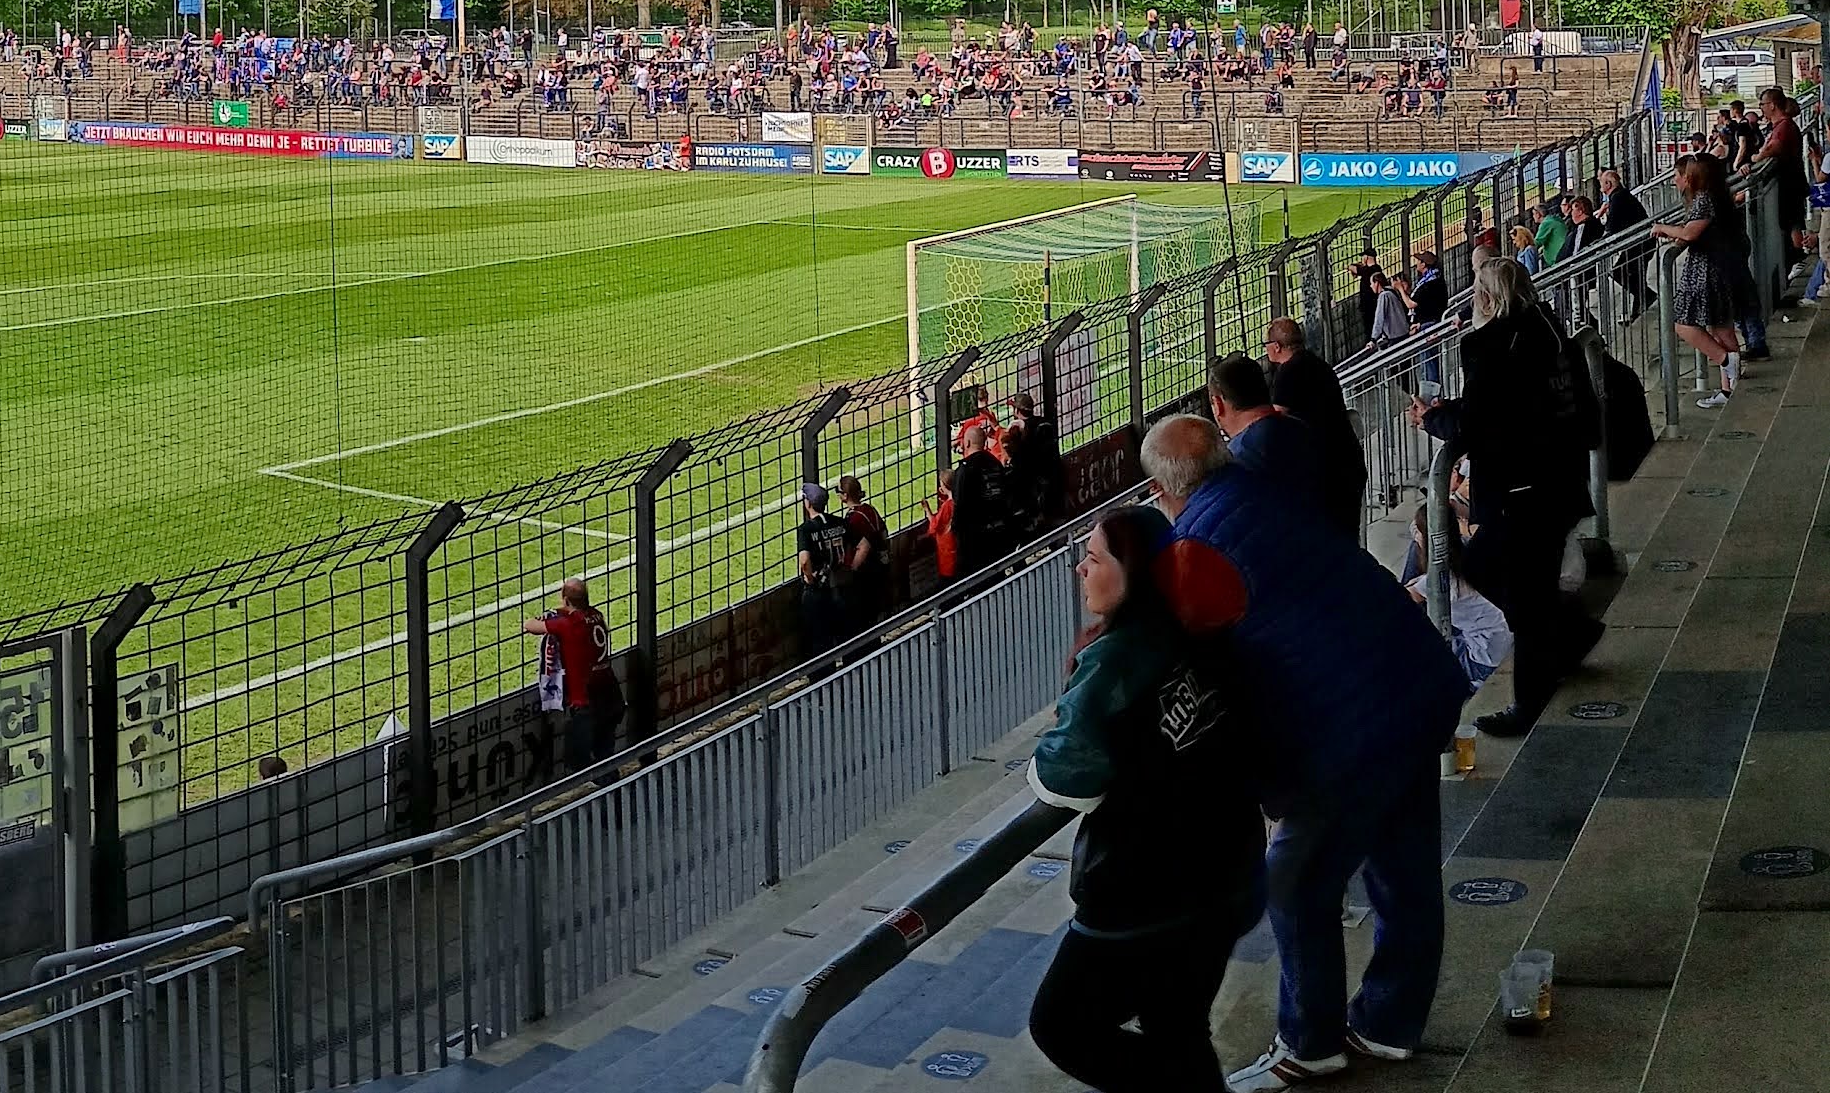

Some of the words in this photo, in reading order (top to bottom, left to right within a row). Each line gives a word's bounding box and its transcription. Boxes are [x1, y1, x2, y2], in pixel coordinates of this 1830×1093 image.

[186, 130, 213, 145] EUCH
[342, 138, 393, 154] TURBINE
[425, 138, 449, 153] SAP
[696, 146, 725, 156] RADIO
[727, 146, 774, 157] POTSDAM
[824, 150, 855, 168] SAP
[696, 156, 708, 166] IM
[876, 155, 920, 168] CRAZY
[1244, 158, 1280, 175] SAP
[1328, 160, 1377, 178] JAKO
[1406, 159, 1458, 178] JAKO
